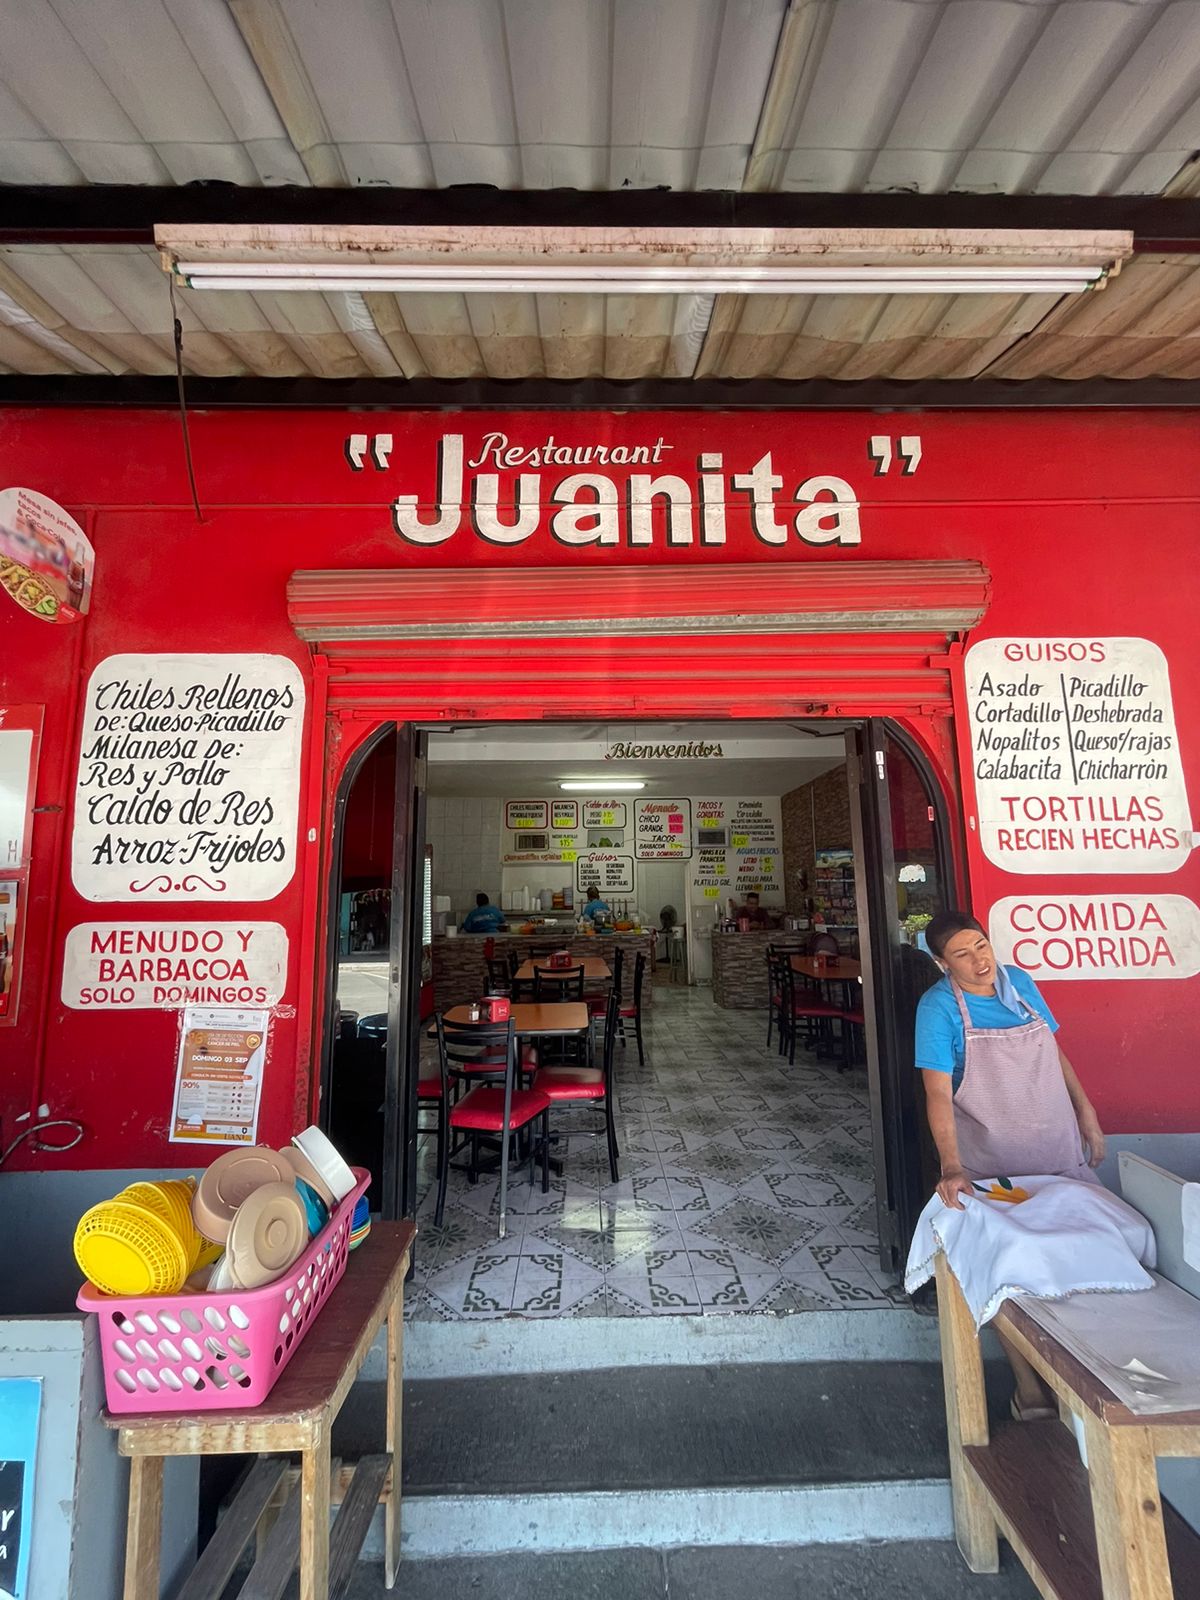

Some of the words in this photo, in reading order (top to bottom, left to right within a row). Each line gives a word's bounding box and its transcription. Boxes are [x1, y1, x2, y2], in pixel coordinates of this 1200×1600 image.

[468, 432, 674, 469] Restaurant
[18, 490, 42, 511] Mesa
[18, 500, 41, 519] tacos
[1004, 642, 1106, 662] GUISOS
[95, 677, 175, 710] Chiles
[178, 673, 294, 711] Rellenos
[978, 672, 1044, 697] Asado
[1069, 674, 1149, 698] Picadillo
[975, 700, 1064, 723] Cortadillo
[1072, 701, 1163, 723] Deshebrada
[83, 733, 198, 759] Milanesa
[203, 739, 244, 759] De:
[605, 741, 724, 759] Bienvenidos
[977, 727, 1061, 756] Nopalitos
[79, 761, 136, 788] Res
[137, 770, 157, 794] y
[159, 760, 231, 786] Pollo
[976, 755, 1062, 780] Calabacita
[1078, 757, 1168, 780] Chicharrón
[87, 789, 174, 825] Caldo
[179, 788, 212, 825] de
[213, 790, 274, 826] Res
[639, 815, 660, 823] CHICO
[1000, 796, 1164, 822] TORTILLAS
[652, 835, 676, 843] TACOS
[997, 828, 1075, 851] RECIEN
[1082, 827, 1180, 850] HECHAS
[588, 852, 617, 862] Guisos
[1010, 902, 1168, 932] COMIDA
[90, 930, 224, 954] MENUDO
[237, 930, 254, 952] Y
[1012, 936, 1176, 970] CORRIDA
[99, 958, 249, 983] BARBACOA
[79, 987, 135, 1005] SOLO
[154, 986, 267, 1004] DOMINGOS
[192, 1055, 222, 1063] DOMINGO
[182, 1081, 200, 1089] 90%
